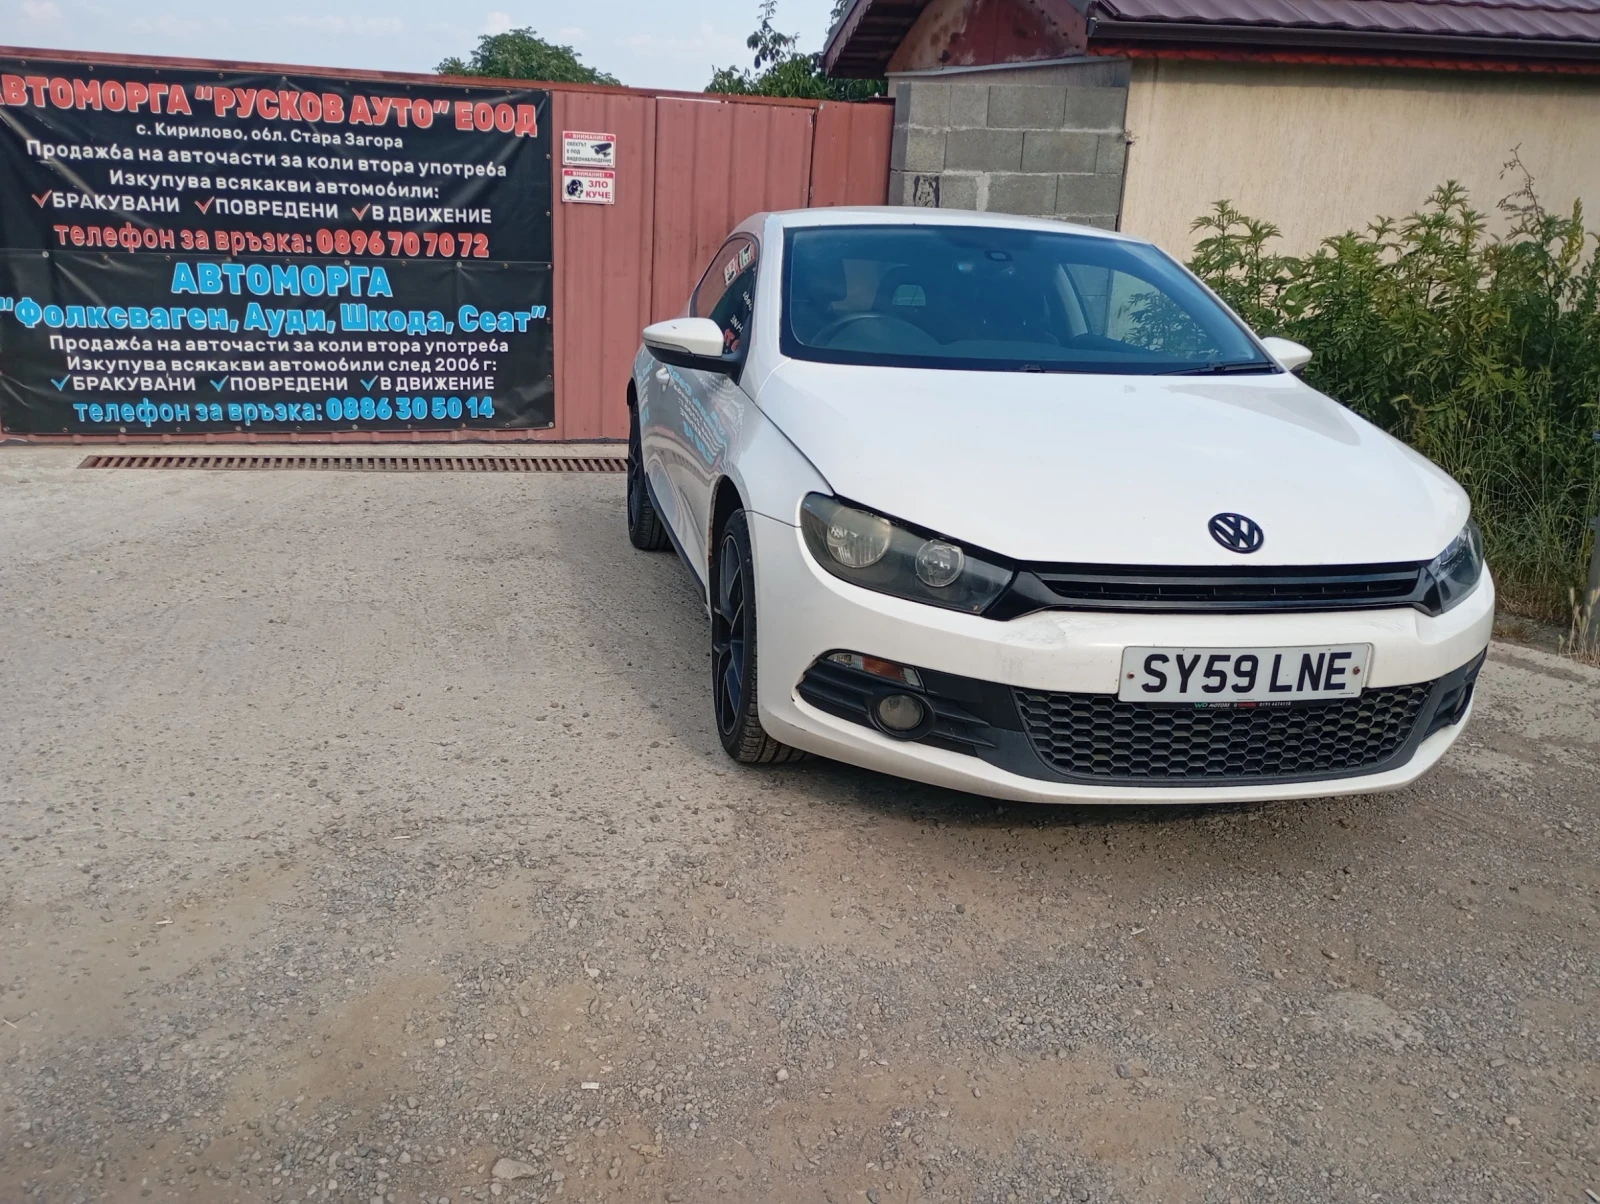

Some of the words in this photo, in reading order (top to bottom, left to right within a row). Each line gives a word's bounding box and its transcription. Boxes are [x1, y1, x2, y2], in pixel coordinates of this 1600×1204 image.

[0, 74, 192, 115] ВТОМОРГА
[195, 86, 345, 124] "РУСКОВ
[349, 95, 450, 129] АУТО"
[455, 101, 538, 138] ЕООД
[136, 123, 151, 136] с.
[155, 122, 248, 141] Кирилово,
[251, 128, 287, 142] обл.
[290, 129, 341, 147] Стара
[345, 132, 403, 149] Загора
[26, 140, 134, 161] Продажба
[139, 148, 163, 162] на
[168, 149, 276, 167] авточасти
[281, 154, 302, 167] за
[307, 155, 354, 170] коли
[358, 158, 414, 176] втора
[419, 161, 507, 178] употреба
[110, 169, 211, 192] Изкупува
[216, 176, 312, 193] всякакви
[316, 180, 439, 199] автомобили:
[586, 190, 610, 199] КУЧЕ
[588, 180, 608, 189] ЗЛО
[52, 192, 180, 213] БРАКУВАНИ
[216, 199, 339, 219] ПОВРЕДЕНИ
[372, 205, 384, 220] В
[388, 206, 492, 223] ДВИЖЕНИЕ
[53, 222, 175, 253] телефон
[180, 229, 209, 250] за
[215, 231, 312, 255] връзка:
[316, 228, 385, 256] 0896
[388, 231, 420, 257] 70
[423, 232, 455, 257] 70
[458, 233, 490, 258] 72
[171, 262, 393, 298] АВТОМОРГА
[244, 302, 336, 337] Ауди,
[340, 303, 454, 335] Шкода,
[458, 304, 546, 333] Сеат"
[49, 335, 151, 353] Продажба
[157, 340, 179, 352] на
[185, 340, 289, 352] авточасти
[293, 341, 314, 352] за
[318, 341, 365, 352] коли
[367, 341, 421, 354] втора
[424, 338, 509, 354] употреба
[67, 355, 167, 374] Изкупува
[171, 359, 265, 372] всякакви
[269, 358, 384, 372] автомобили
[388, 360, 431, 373] след
[434, 358, 480, 372] 2006
[483, 359, 497, 372] г:
[72, 376, 196, 391] БРАКУВАНИ
[230, 376, 348, 392] ПОВРЕДЕНИ
[380, 377, 392, 391] В
[396, 376, 495, 392] ДВИЖЕНИЕ
[73, 398, 189, 427] телефон
[195, 403, 223, 422] за
[228, 401, 323, 426] връзка:
[326, 397, 392, 421] 0886
[395, 397, 428, 420] 30
[431, 396, 463, 420] 50
[466, 396, 495, 419] 14
[1141, 653, 1259, 694] SY59
[1268, 652, 1352, 693] LNE
